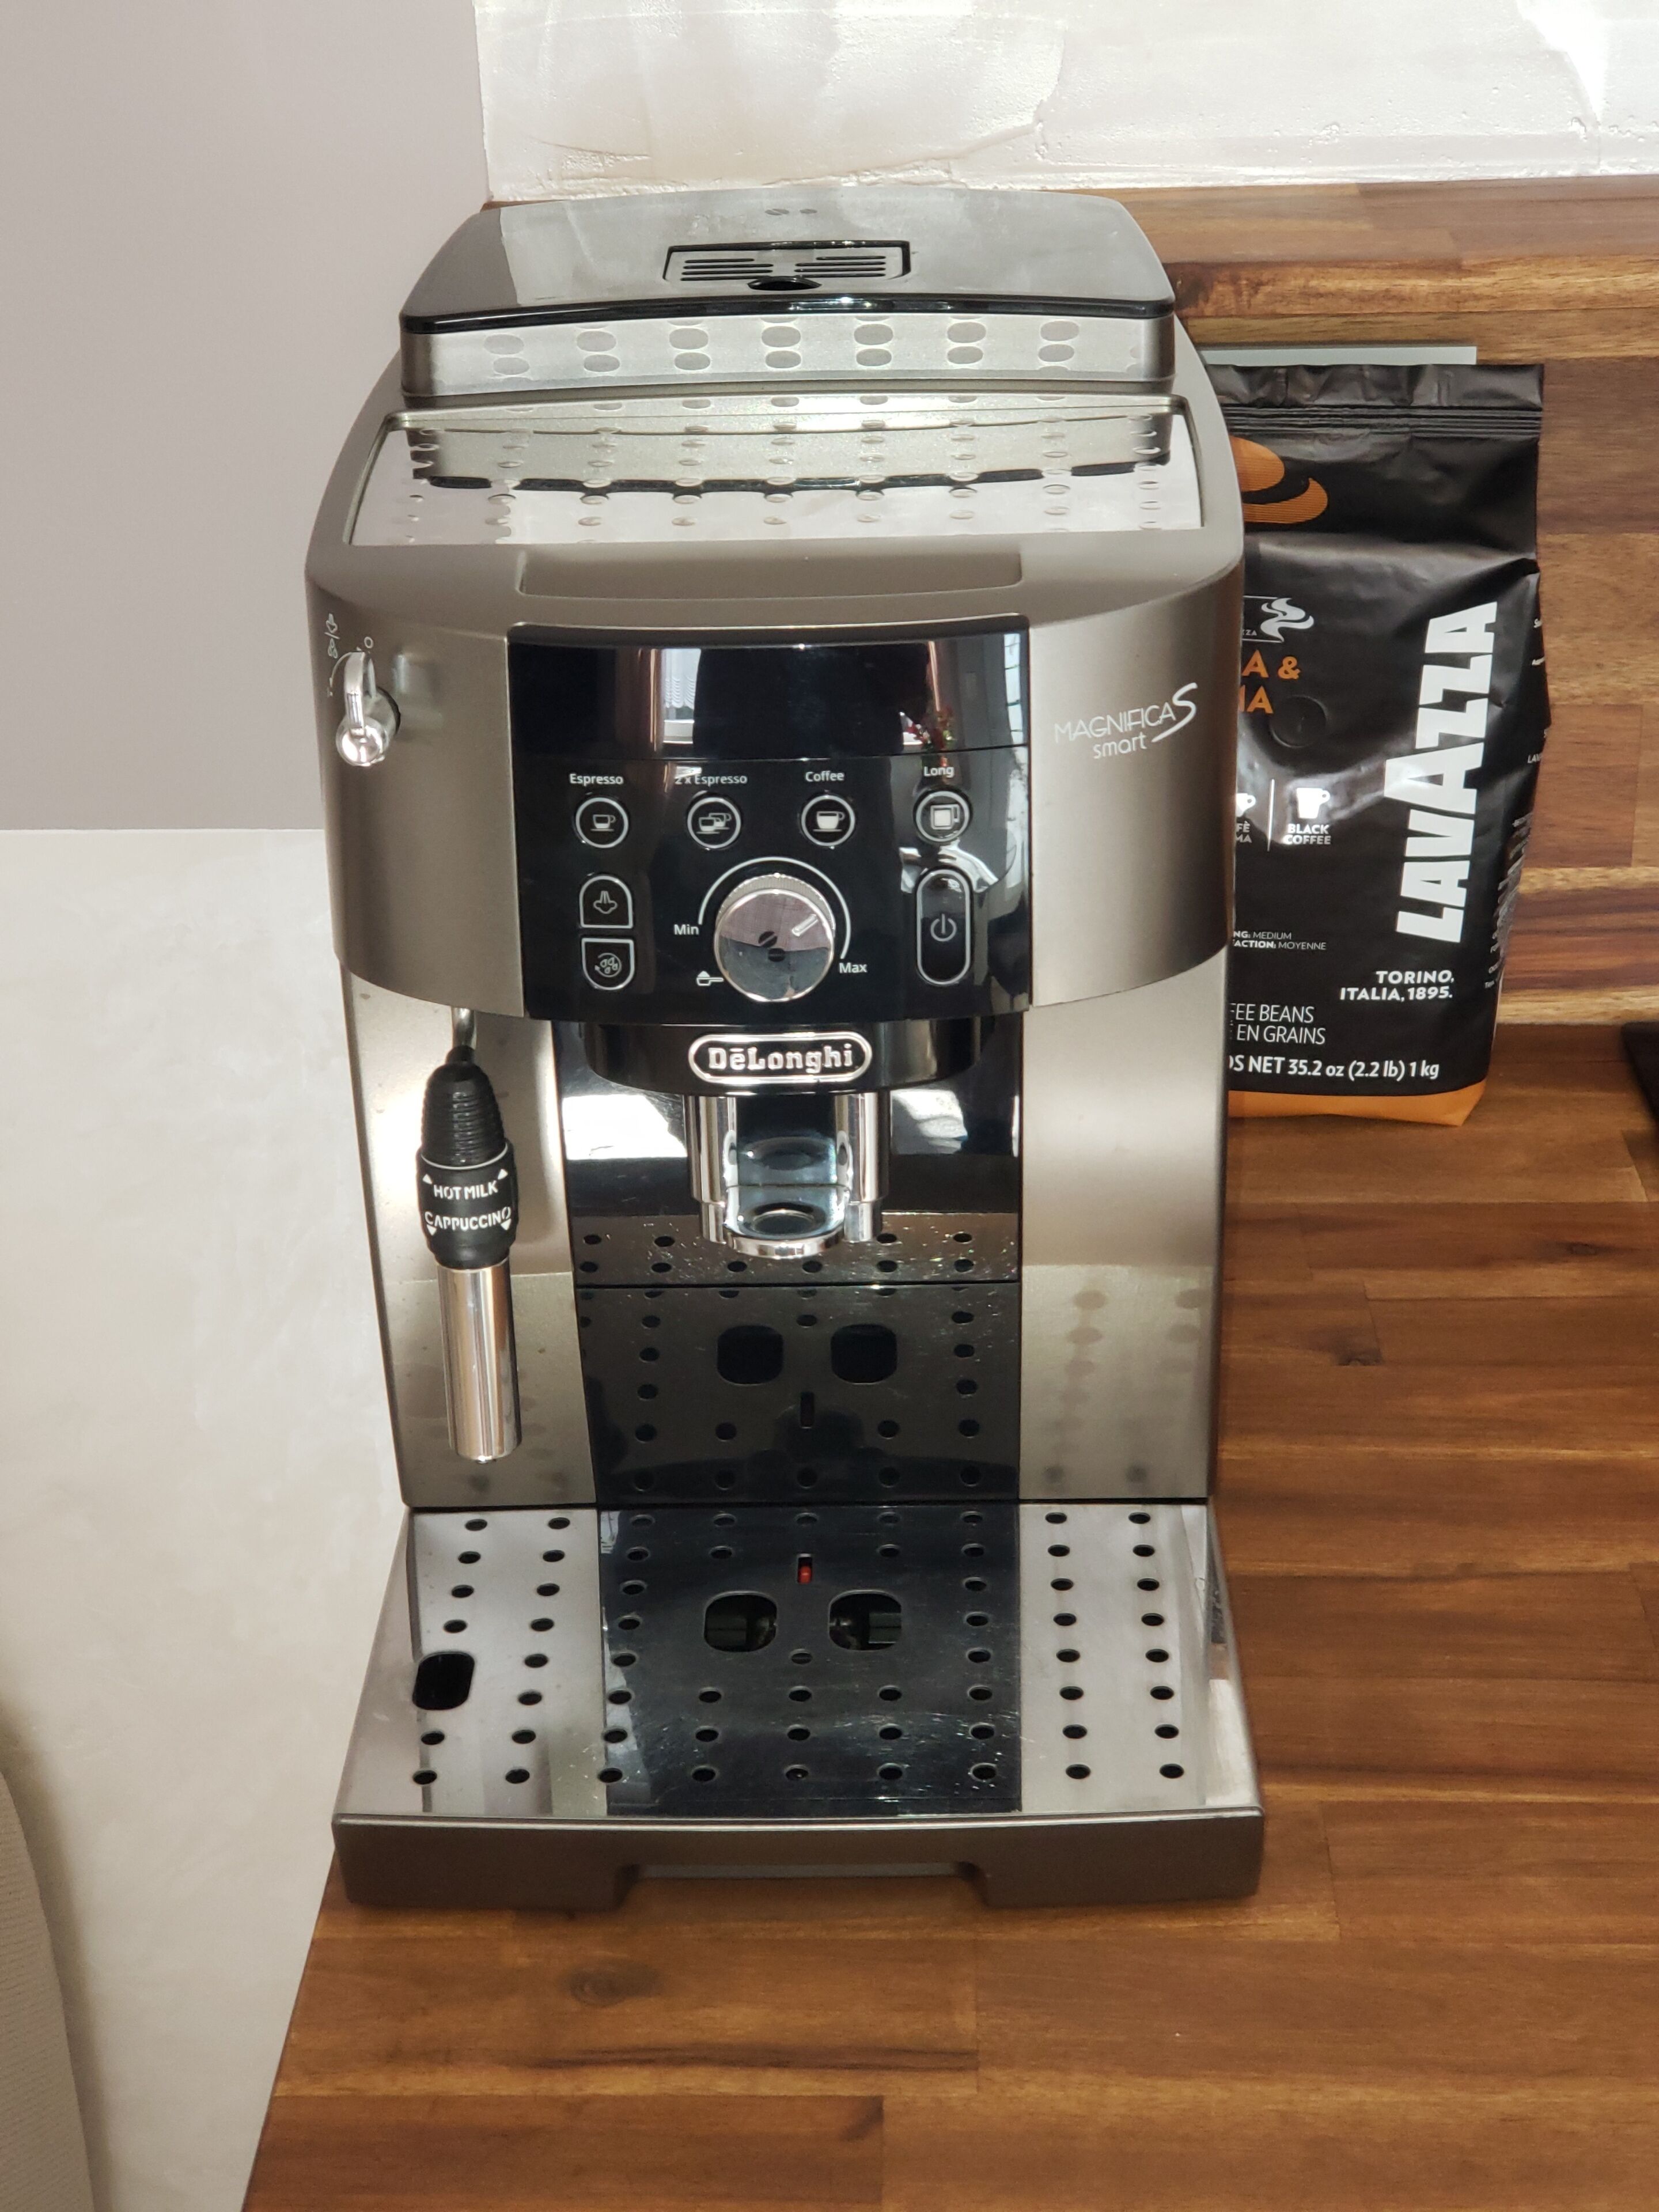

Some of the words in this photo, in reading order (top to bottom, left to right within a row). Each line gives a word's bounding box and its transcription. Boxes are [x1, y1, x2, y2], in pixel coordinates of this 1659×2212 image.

[1277, 656, 1301, 679] &
[1054, 702, 1176, 744] MAGNIFICA
[1093, 732, 1147, 759] smart
[805, 770, 845, 782] Coffee
[924, 766, 955, 778] Long
[1384, 601, 1497, 942] LAVAZZA
[569, 773, 624, 787] Espresso
[695, 774, 748, 787] Espresso
[1287, 823, 1330, 835] BLACK
[1285, 834, 1331, 845] COFFEE
[674, 923, 699, 935] Min
[1253, 931, 1291, 940] MEDIUM
[1232, 939, 1276, 949] ACTION:
[1278, 941, 1327, 950] MOYENNE
[839, 962, 868, 974] Max
[1376, 969, 1455, 984] TORINO,
[1339, 987, 1405, 1002] ITALIA,
[1407, 986, 1453, 1001] 1895.
[1259, 1004, 1315, 1024] BEANS
[1237, 1024, 1260, 1041] EN
[1263, 1025, 1326, 1045] GRAINS
[1248, 1055, 1285, 1074] NET
[1287, 1059, 1323, 1076] 35.2
[1325, 1065, 1344, 1077] oz
[1348, 1060, 1380, 1082] (2.2
[1383, 1060, 1406, 1082] lb)
[1410, 1062, 1417, 1077] 1
[1420, 1060, 1440, 1080] kg
[434, 1184, 462, 1200] HOT
[464, 1180, 498, 1200] MILK
[424, 1206, 512, 1231] CAPPUCCINO
